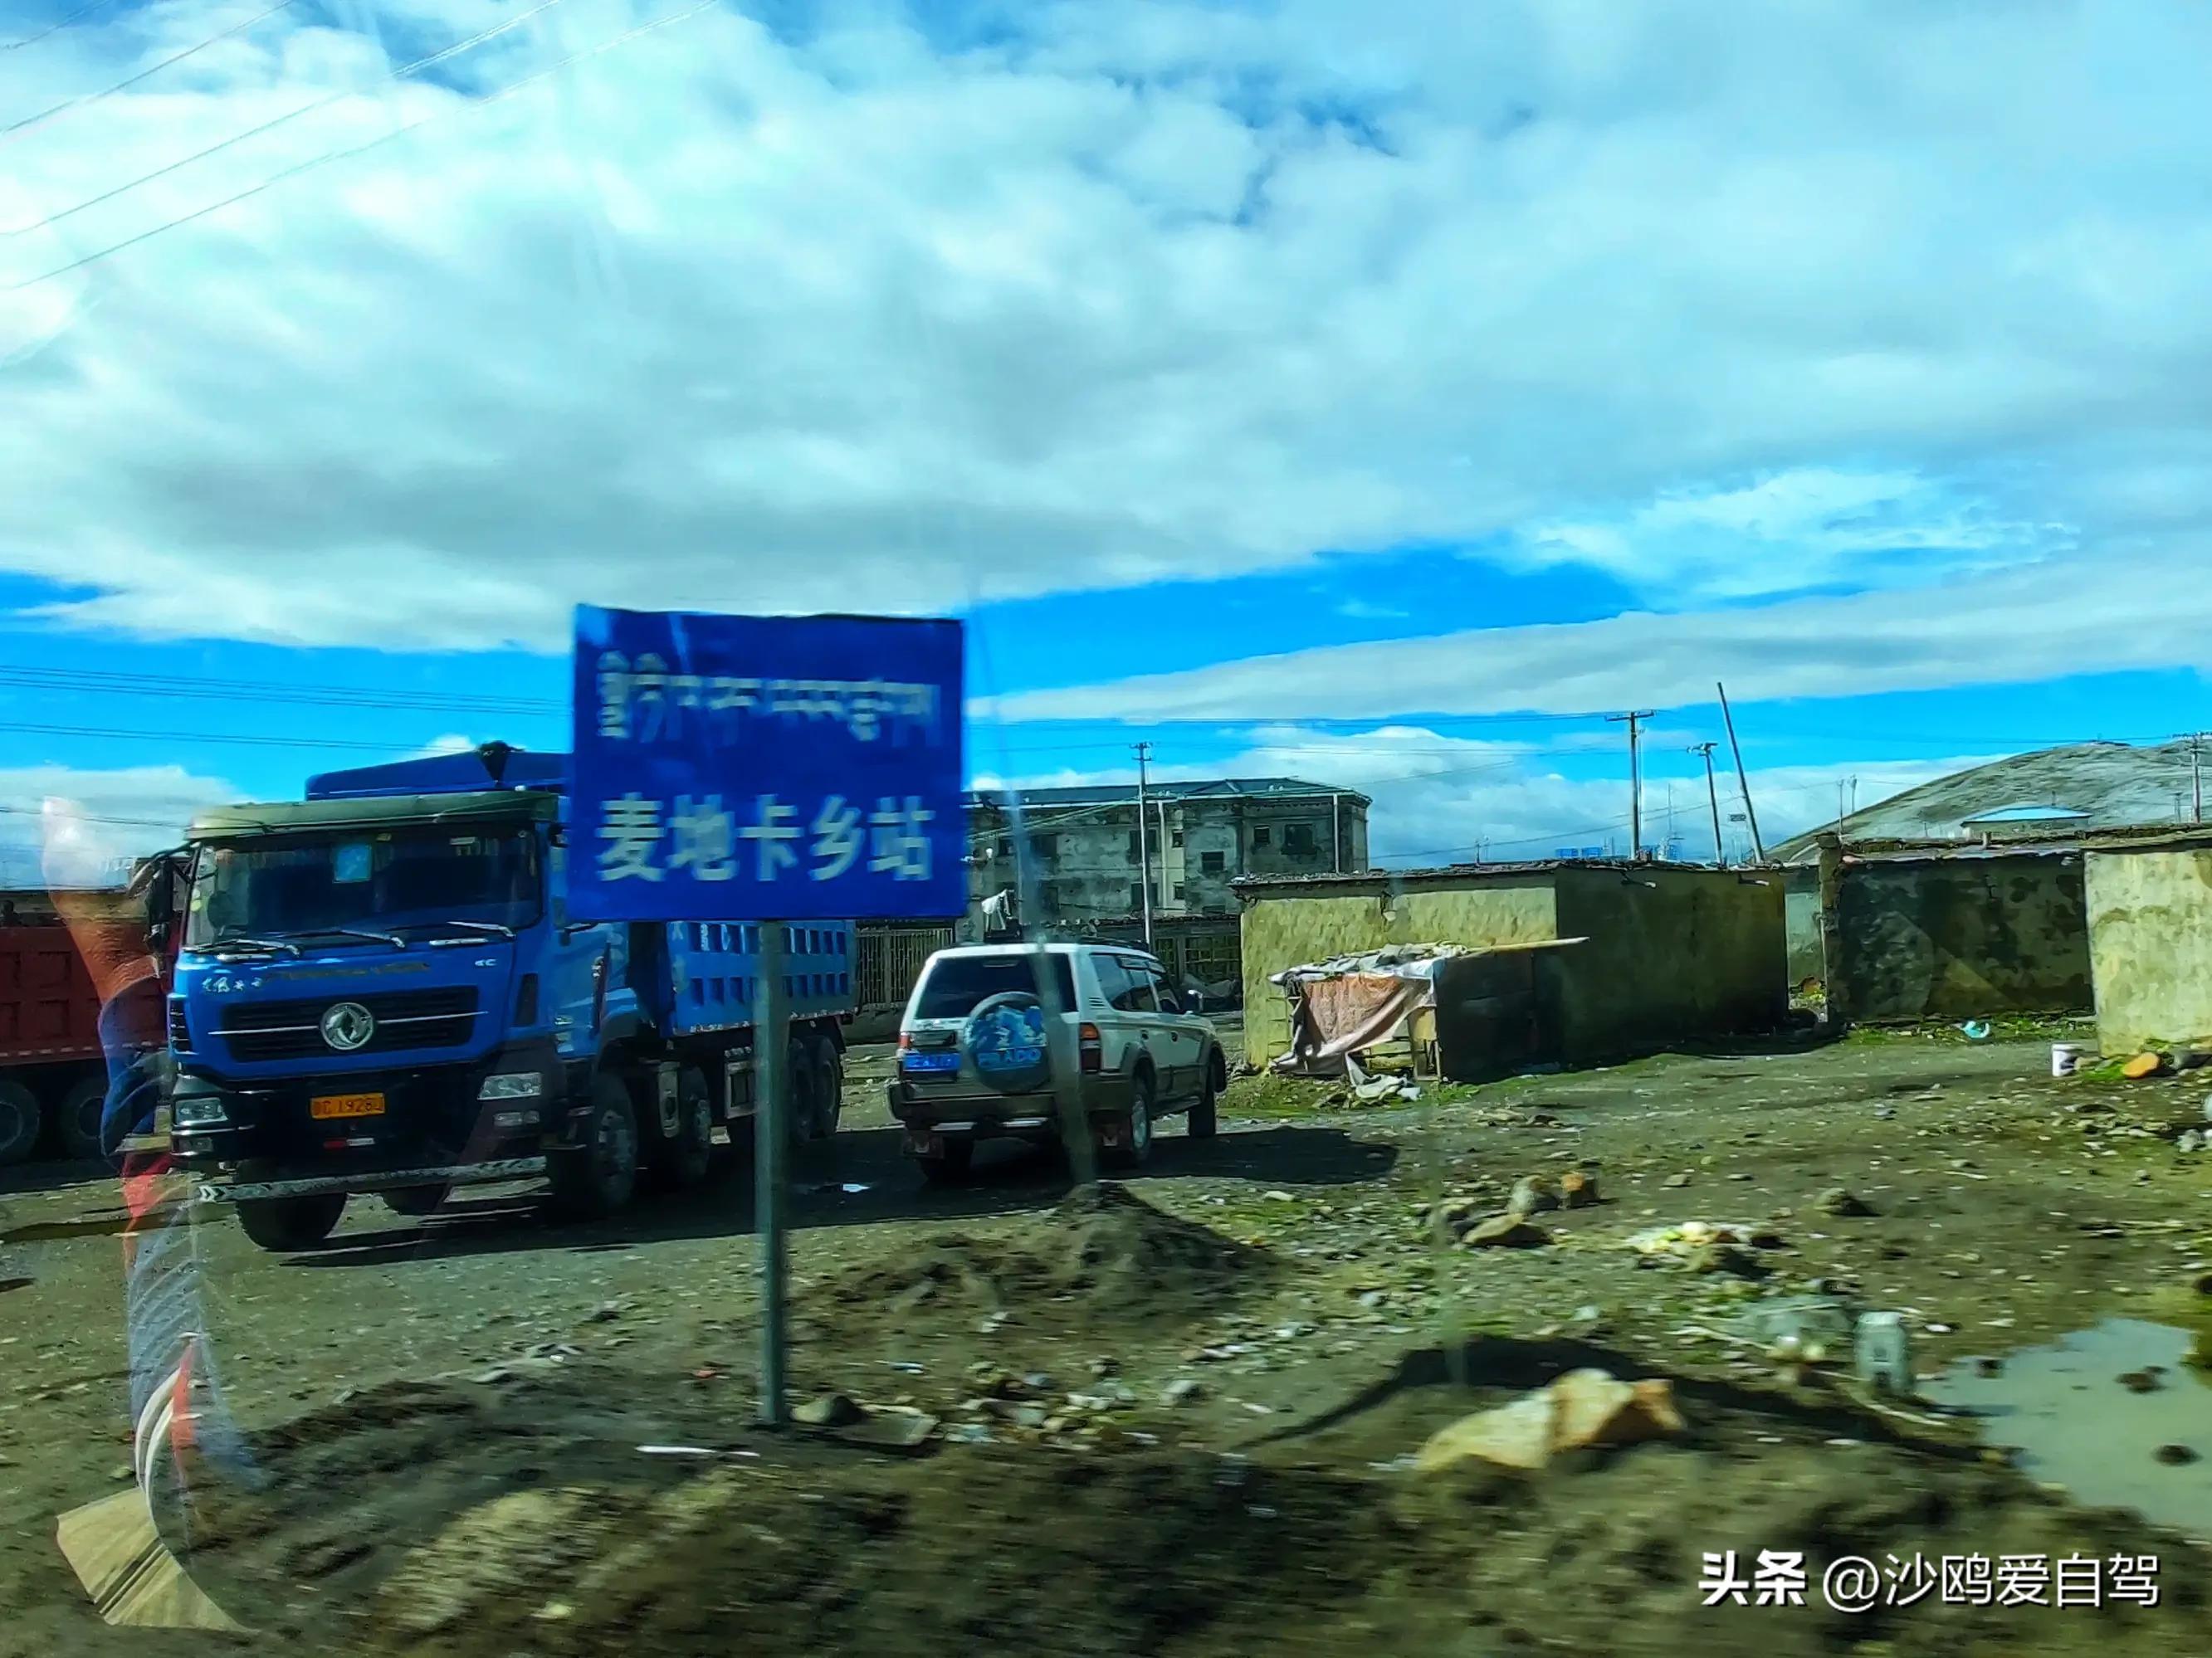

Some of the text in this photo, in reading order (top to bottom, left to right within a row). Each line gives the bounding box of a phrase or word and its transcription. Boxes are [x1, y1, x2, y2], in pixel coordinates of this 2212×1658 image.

[595, 792, 936, 882] 麦地卡乡站
